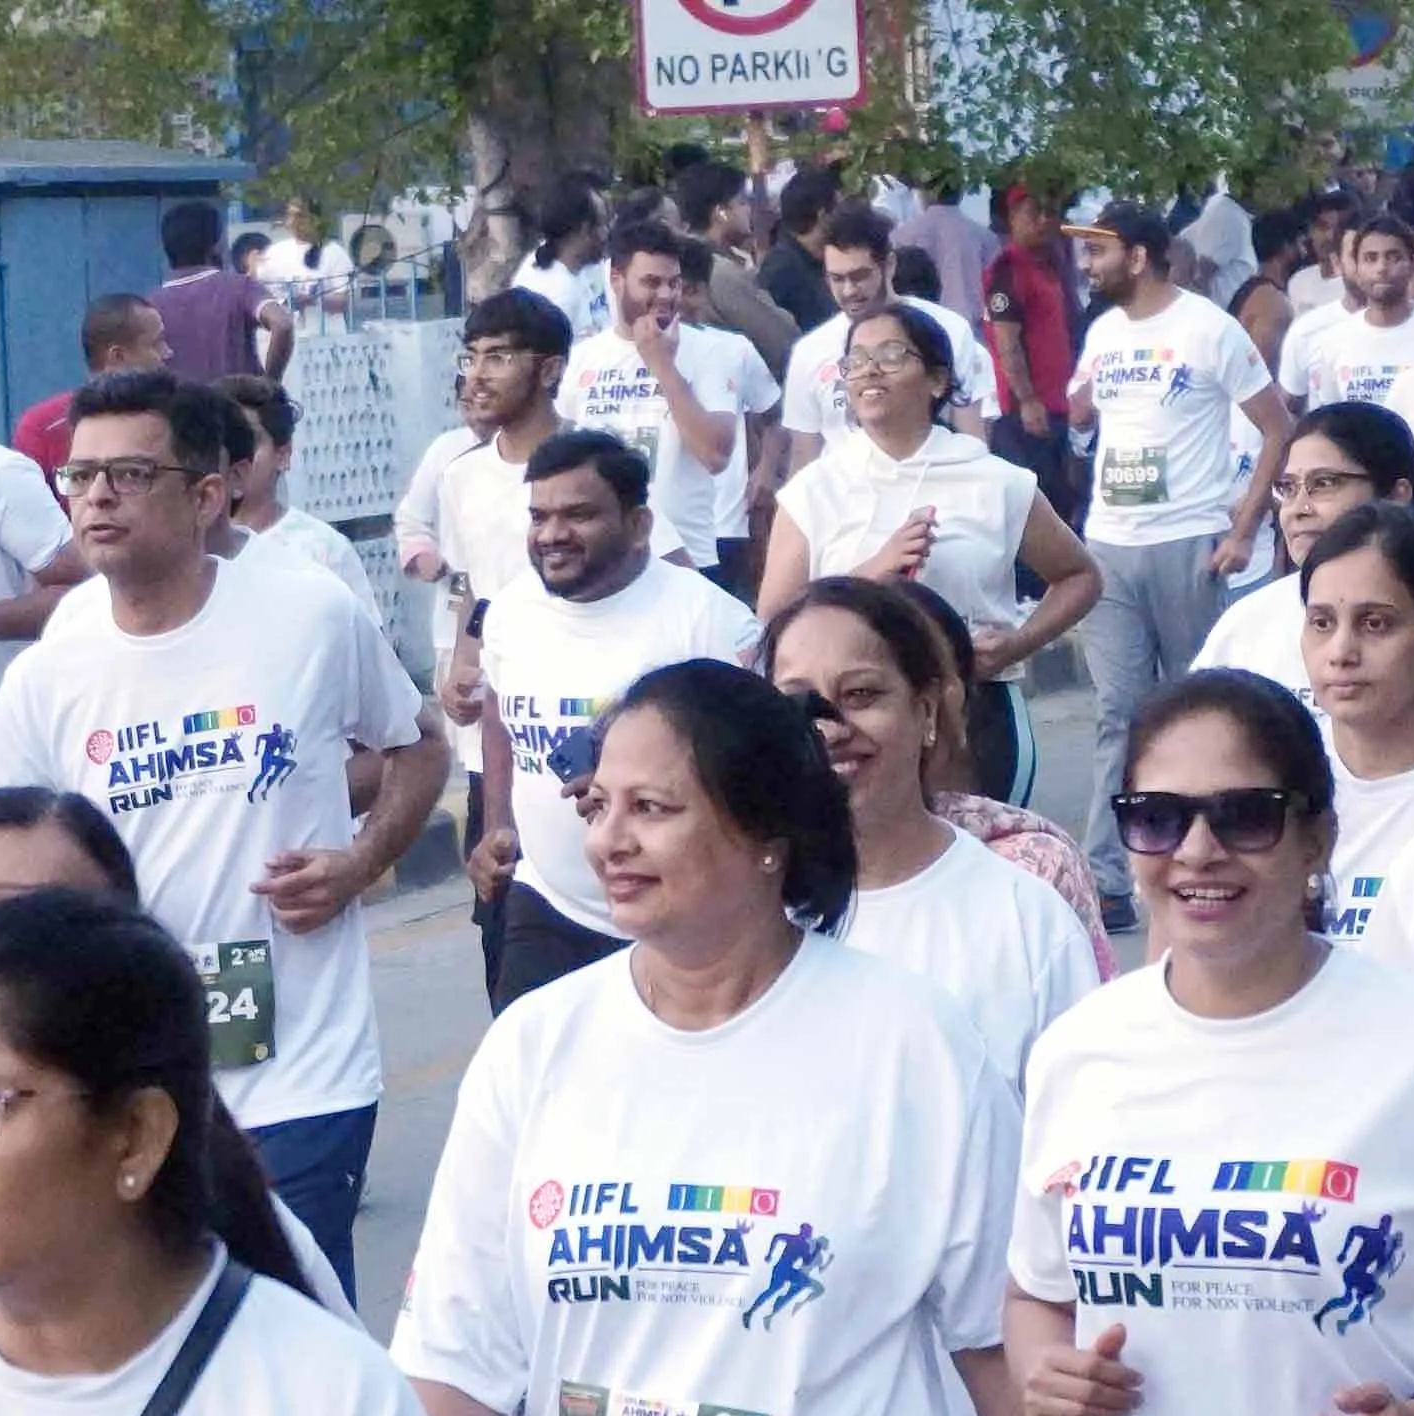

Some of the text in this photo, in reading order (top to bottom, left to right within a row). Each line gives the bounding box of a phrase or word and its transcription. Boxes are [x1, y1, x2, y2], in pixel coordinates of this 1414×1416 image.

[656, 56, 699, 86] NO
[598, 369, 625, 382] IIFL
[1347, 378, 1394, 392] AHIMS
[117, 721, 168, 752] IIFL
[108, 738, 244, 789] AHIMSA
[110, 783, 172, 813] RUN
[569, 1182, 639, 1215] IIFL
[548, 1223, 749, 1270] AHIMSA
[1069, 1204, 1321, 1266] AHIMSA
[548, 1274, 631, 1303] RUN
[1171, 1280, 1253, 1295] FOR PEACE
[1172, 1296, 1202, 1309] FOR
[1210, 1297, 1239, 1310] NON
